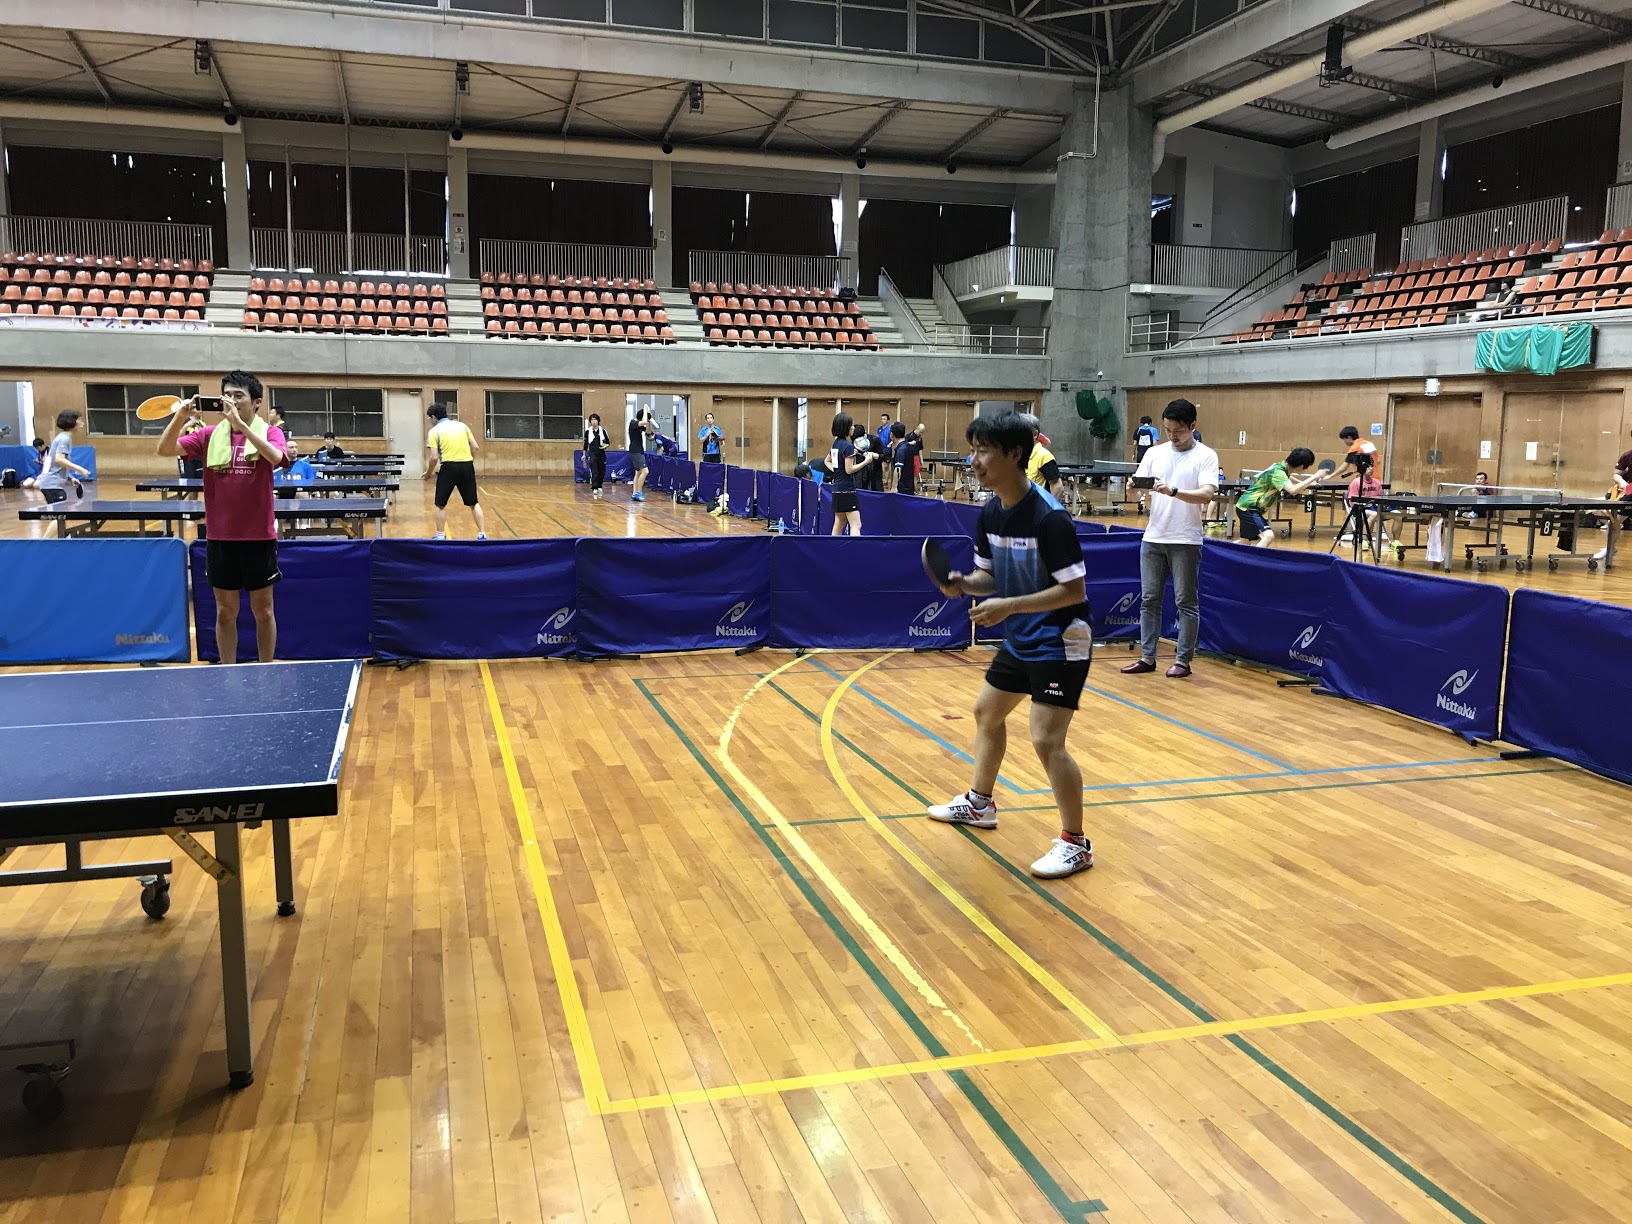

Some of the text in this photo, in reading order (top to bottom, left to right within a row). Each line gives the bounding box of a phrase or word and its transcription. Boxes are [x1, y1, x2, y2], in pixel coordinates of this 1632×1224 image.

[1306, 500, 1313, 512] 9
[1543, 520, 1551, 535] 8
[715, 625, 758, 637] Nittaku
[908, 625, 952, 637] Nittaku
[536, 632, 578, 645] Nittak
[1436, 693, 1477, 720] Nittaku
[173, 802, 265, 824] SAN-EI
